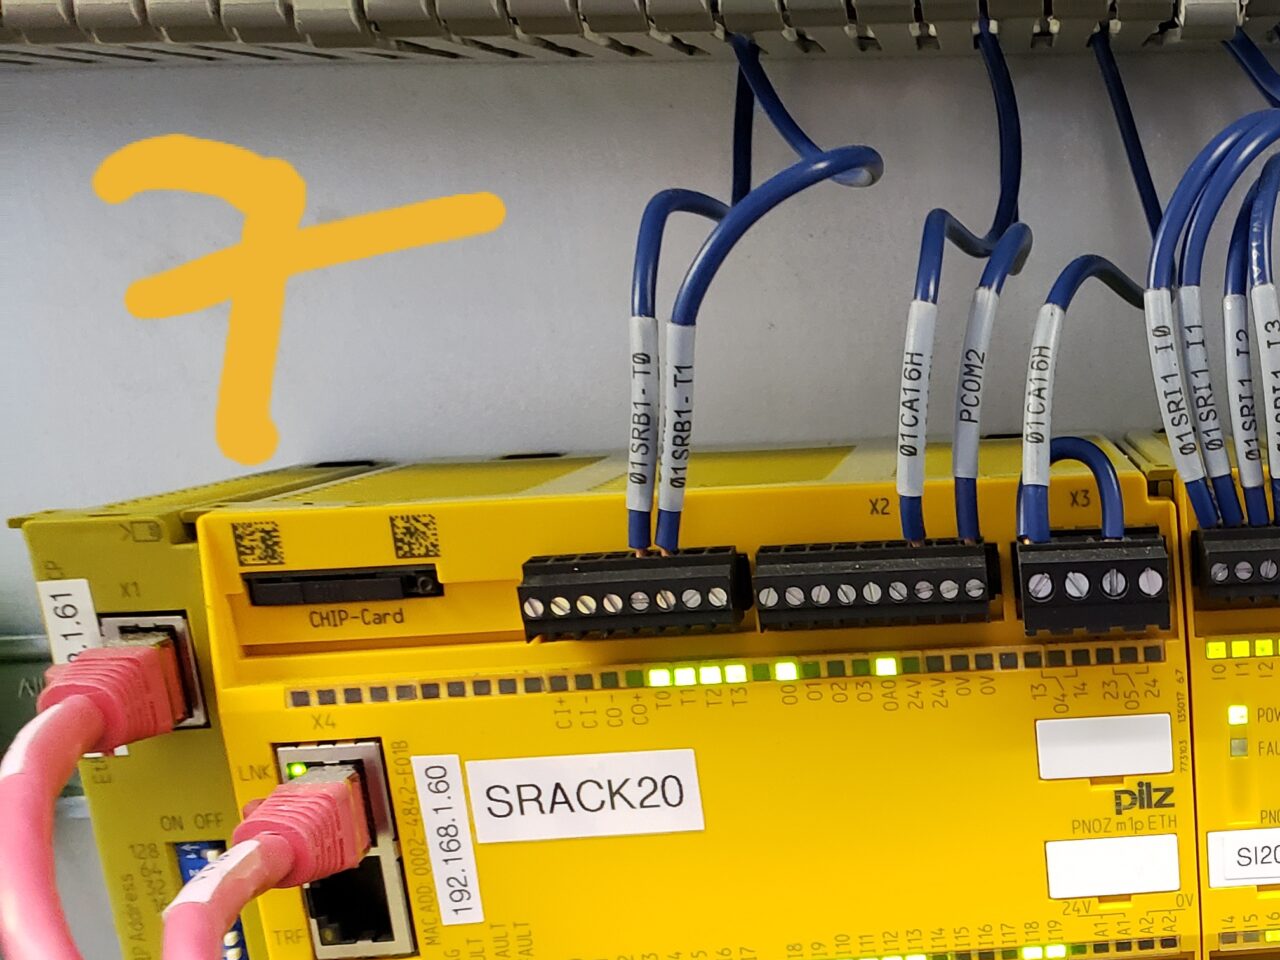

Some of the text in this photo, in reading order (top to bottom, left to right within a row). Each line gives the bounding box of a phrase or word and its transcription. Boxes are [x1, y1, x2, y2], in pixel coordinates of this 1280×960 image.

[900, 352, 924, 457] 01CA16H
[869, 498, 890, 515] X2
[1070, 489, 1091, 506] X3
[308, 607, 405, 630] CHIP-Card
[485, 774, 685, 819] SRACK20
[1114, 780, 1176, 816] pilz
[1071, 817, 1113, 834] PNOZ
[1147, 814, 1177, 830] ETH
[424, 764, 472, 916] 192.168.1.60
[1062, 899, 1092, 917] 24V
